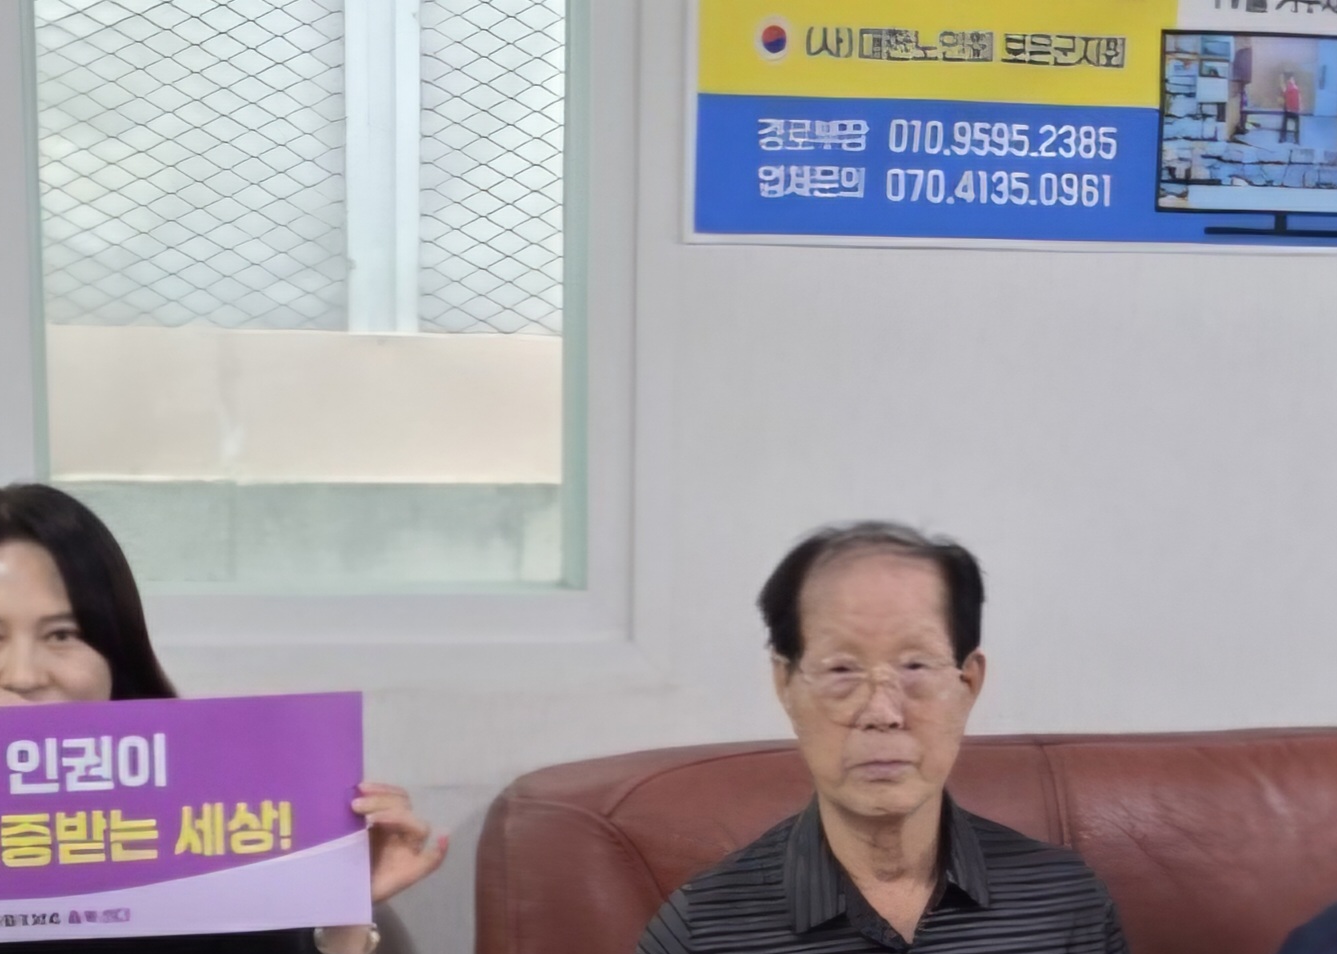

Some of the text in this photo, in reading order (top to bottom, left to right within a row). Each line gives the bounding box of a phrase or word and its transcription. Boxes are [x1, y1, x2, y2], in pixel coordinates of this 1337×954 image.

[889, 119, 1117, 159] 010.9595.2385
[886, 168, 1111, 207] 070.4135.0961
[6, 733, 167, 794] 인권이
[174, 800, 292, 856] 세상!
